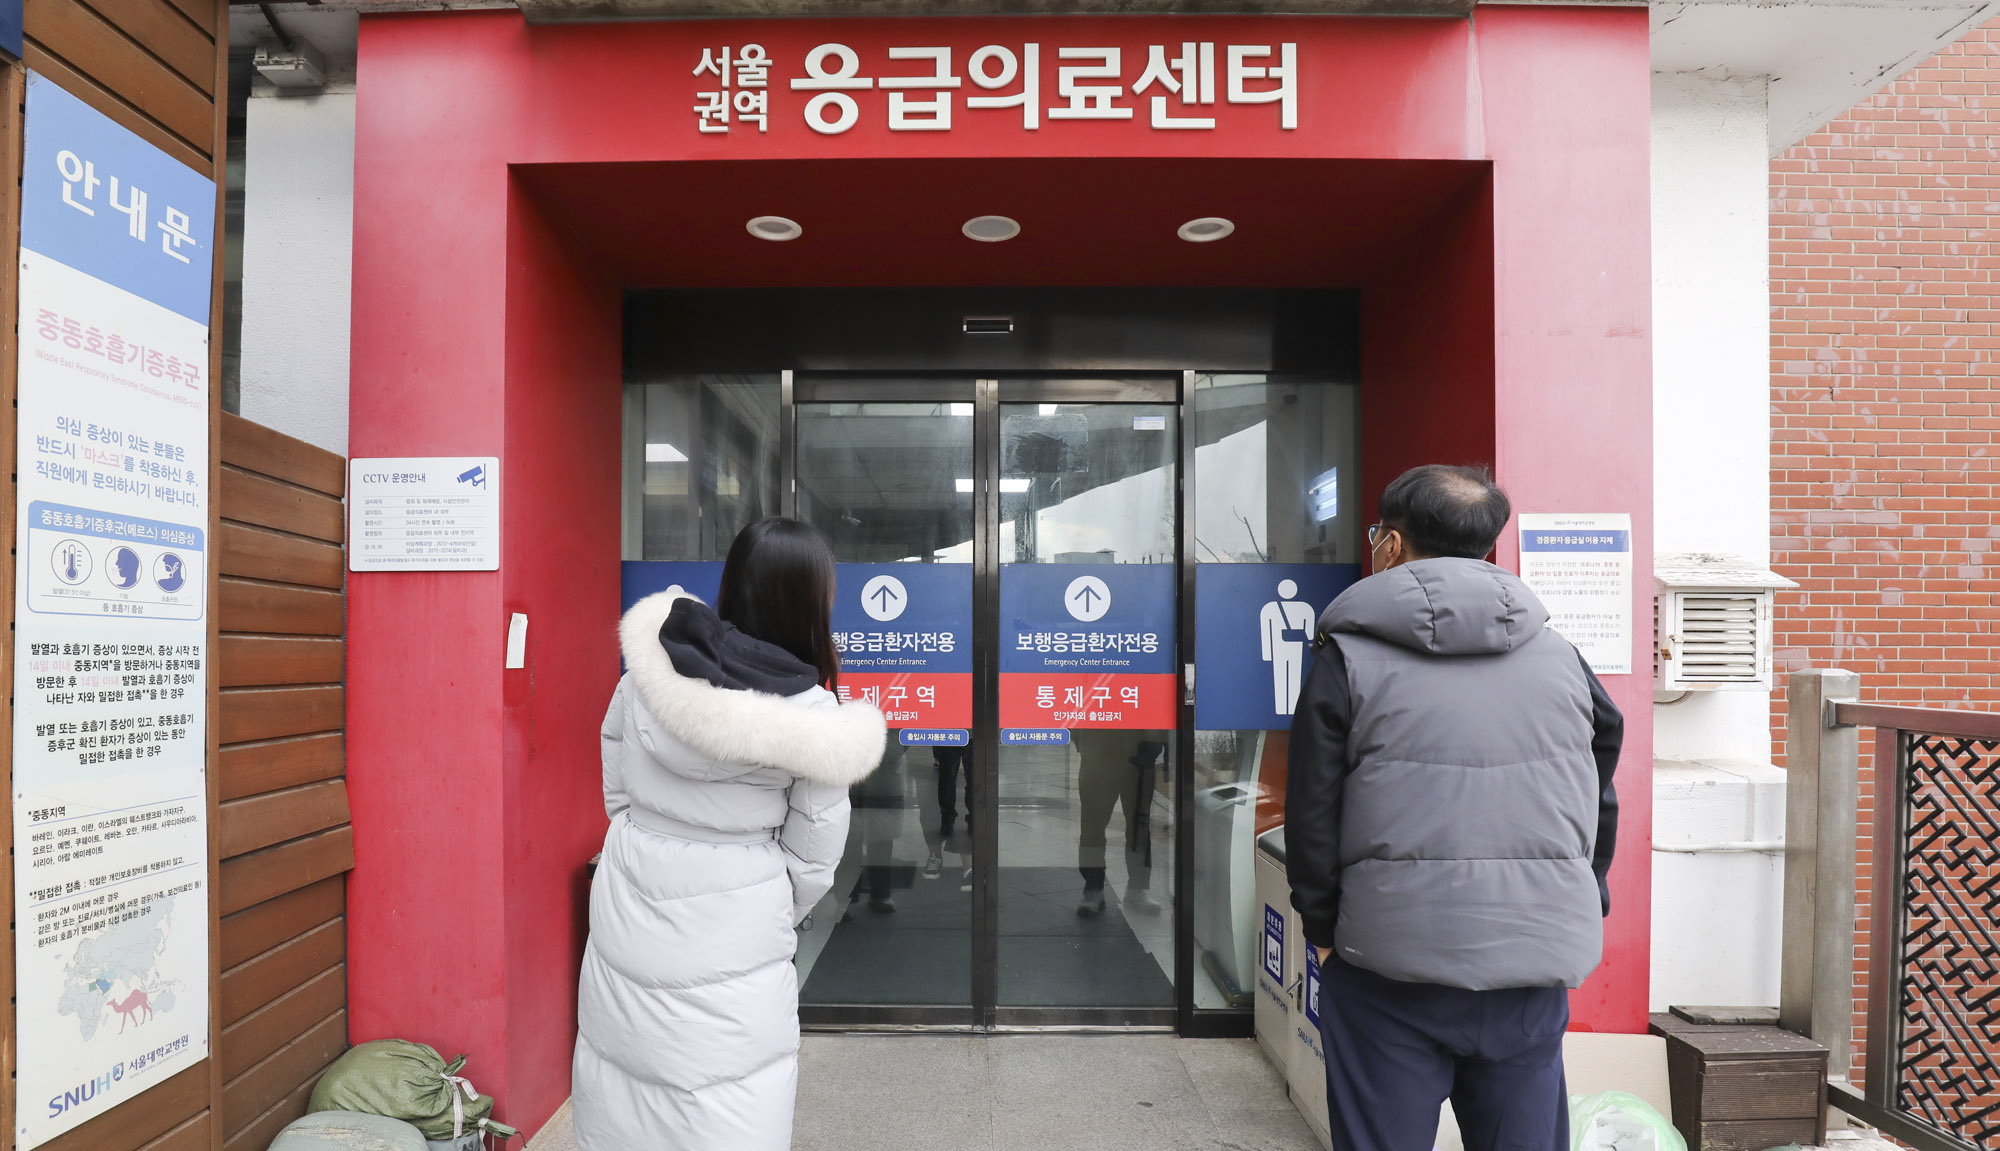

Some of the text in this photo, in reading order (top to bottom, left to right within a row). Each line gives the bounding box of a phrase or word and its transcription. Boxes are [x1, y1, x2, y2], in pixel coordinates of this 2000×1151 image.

[692, 44, 773, 88] 서울
[790, 42, 1297, 134] 응급의료센터
[694, 90, 768, 133] 권역
[57, 149, 195, 264] 안내문
[36, 307, 200, 391] 중동호흡기증후군
[56, 416, 184, 462] 의심 증상이 있는 분들은
[37, 435, 76, 459] 반드시
[140, 462, 182, 483] 착용하신
[37, 461, 199, 508] 직원에게 문의하시기 바랍니다.
[363, 473, 426, 483] CCTV 운영안내
[41, 510, 195, 545] 중동호흡기증후군(메르스) 의심증상
[1536, 536, 1614, 544] 경증환자 응급실 이용 자제
[102, 603, 144, 614] 등 호흡기 증상
[31, 644, 200, 656] 발열과 호흡기 증상이 있으면서, 증상 시작 전
[832, 632, 956, 652] 행응급환자전용
[1016, 632, 1159, 653] 보행응급환자전용
[53, 660, 71, 672] 이내
[124, 660, 163, 670] 방문하거나
[166, 660, 200, 670] 중동지역을
[842, 658, 927, 667] Emergency Center Entrance
[1044, 658, 1130, 667] Emergency Center Entrance
[36, 676, 65, 689] 방문한
[68, 676, 77, 687] 후
[122, 675, 146, 686] 발열과
[149, 674, 171, 685] 호흡기
[174, 674, 195, 684] 증상이
[46, 692, 74, 704] 나타난
[78, 692, 95, 703] 자와
[98, 690, 123, 703] 밀접한
[160, 689, 167, 699] 한
[170, 688, 185, 699] 경우
[36, 724, 55, 736] 발열
[59, 722, 77, 734] 또는
[81, 720, 107, 733] 호흡기
[110, 718, 134, 731] 증상이
[158, 714, 194, 727] 중동호흡기
[1054, 712, 1122, 721] 인가자외 출입금지
[48, 728, 186, 752] 증후군 확진 환자가 증상이 있는 동안
[1009, 733, 1062, 741] 출입시 자동문 주의
[80, 745, 162, 765] 밀접한 접촉을 한 경우
[32, 846, 104, 869] 시리아, 아랍 에미레이트
[66, 882, 80, 893] 접촉
[89, 876, 107, 886] 적절한
[109, 866, 148, 882] 개인보호장비를
[150, 860, 171, 871] 착용하지
[38, 911, 58, 922] 환자와
[72, 902, 91, 913] 이내에
[93, 896, 105, 907] 머문
[107, 892, 119, 902] 경우
[49, 1072, 110, 1119] SNUH
[128, 1034, 189, 1071] 서울대학교병원
